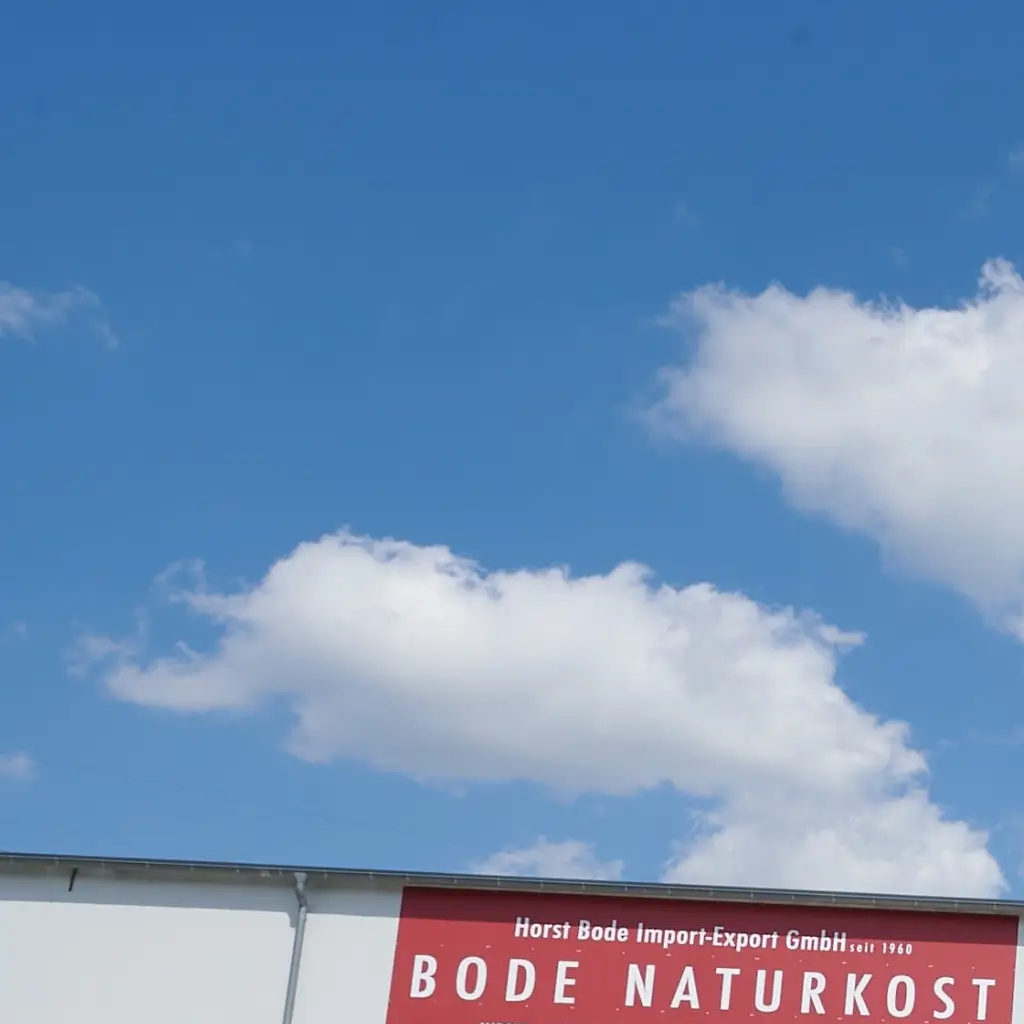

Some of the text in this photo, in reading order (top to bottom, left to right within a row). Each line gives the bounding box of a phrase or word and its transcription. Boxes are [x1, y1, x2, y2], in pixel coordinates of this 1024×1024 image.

[515, 917, 912, 955] Horst Bode Import-Export GmbH seit 1960
[410, 955, 995, 1020] BODE NATURKOST
